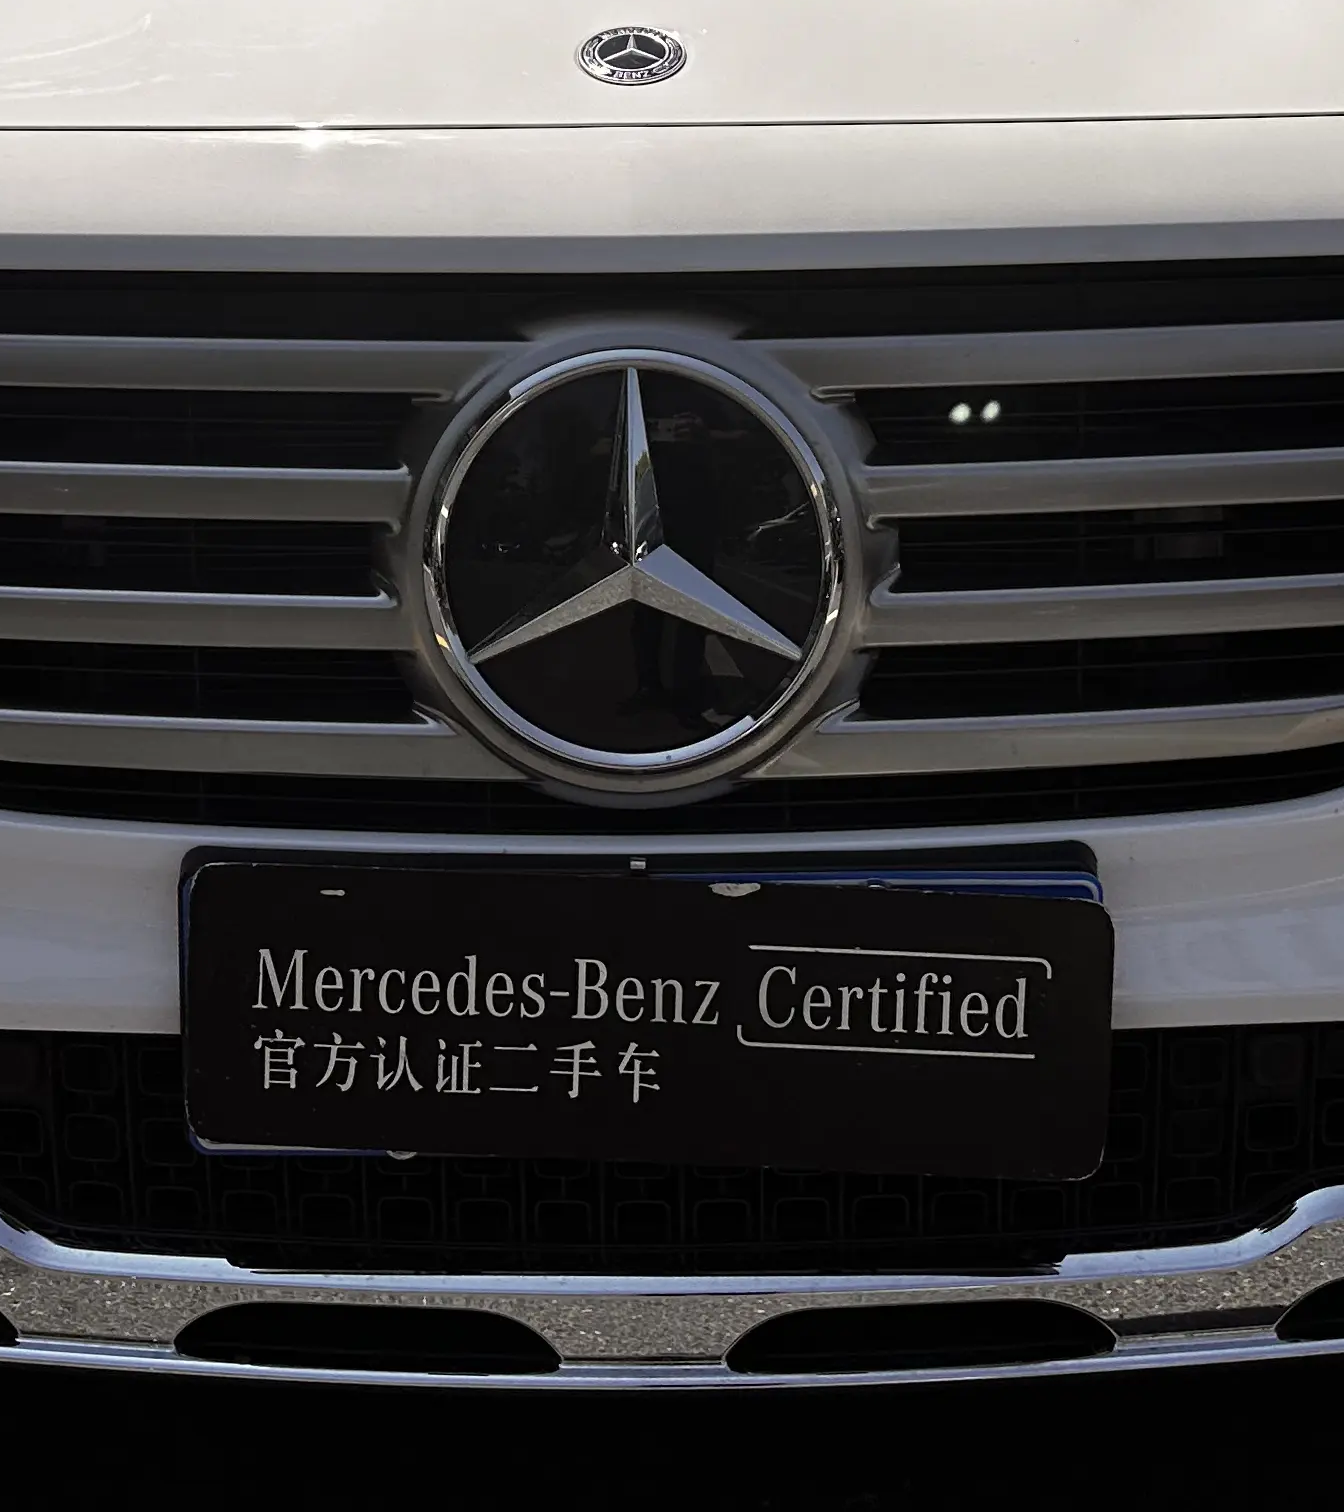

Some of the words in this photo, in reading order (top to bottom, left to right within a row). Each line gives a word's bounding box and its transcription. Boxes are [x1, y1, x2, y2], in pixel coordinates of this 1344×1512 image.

[252, 949, 721, 1026] Mercedes-Benz
[758, 966, 1029, 1040] Certified
[254, 1030, 661, 1103] 官方认证二手车
